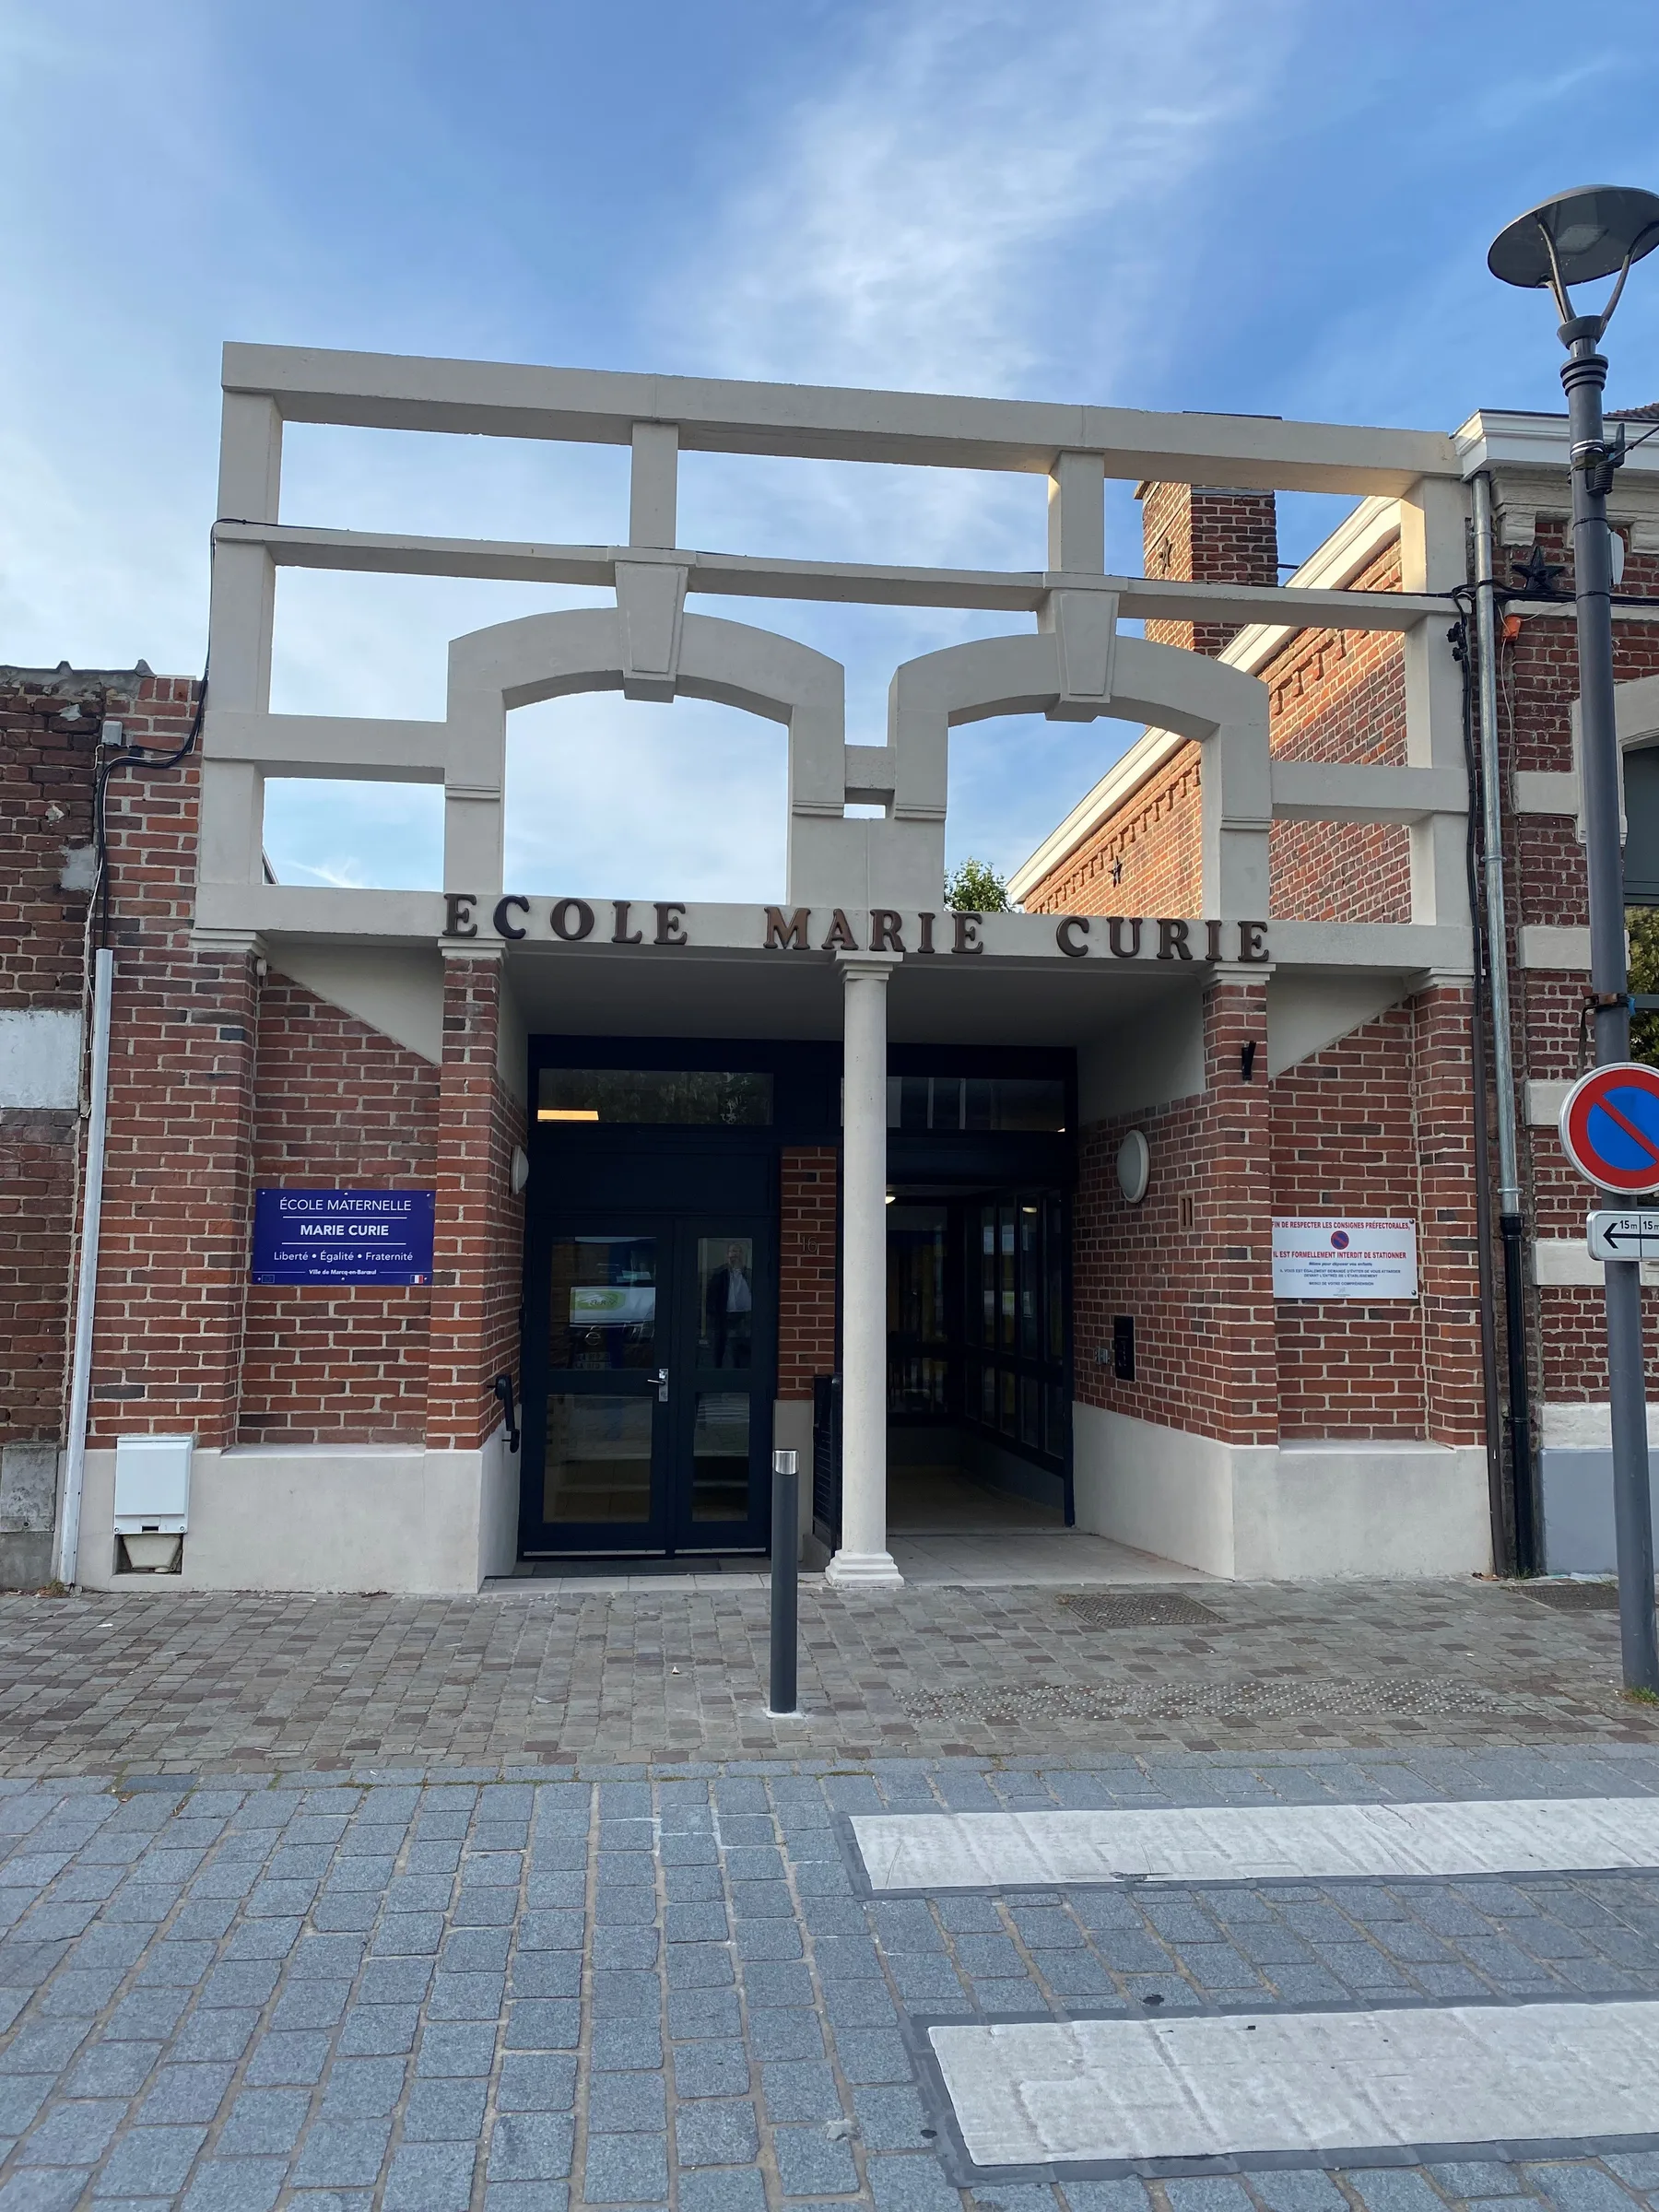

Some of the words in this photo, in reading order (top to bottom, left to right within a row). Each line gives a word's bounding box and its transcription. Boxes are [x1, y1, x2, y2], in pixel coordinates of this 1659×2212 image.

[442, 892, 688, 946] ECOLE
[763, 905, 984, 955] MARIE
[1056, 916, 1269, 962] CURIE
[279, 1196, 324, 1211] ÉCOLE
[327, 1199, 412, 1211] MATERNELLE
[300, 1224, 345, 1236] MARIE
[347, 1224, 389, 1236] CURIE
[1334, 1221, 1365, 1230] CONSIGNES
[274, 1251, 309, 1261] Liberté
[320, 1251, 354, 1263] Égalité
[365, 1252, 414, 1261] Fraternité
